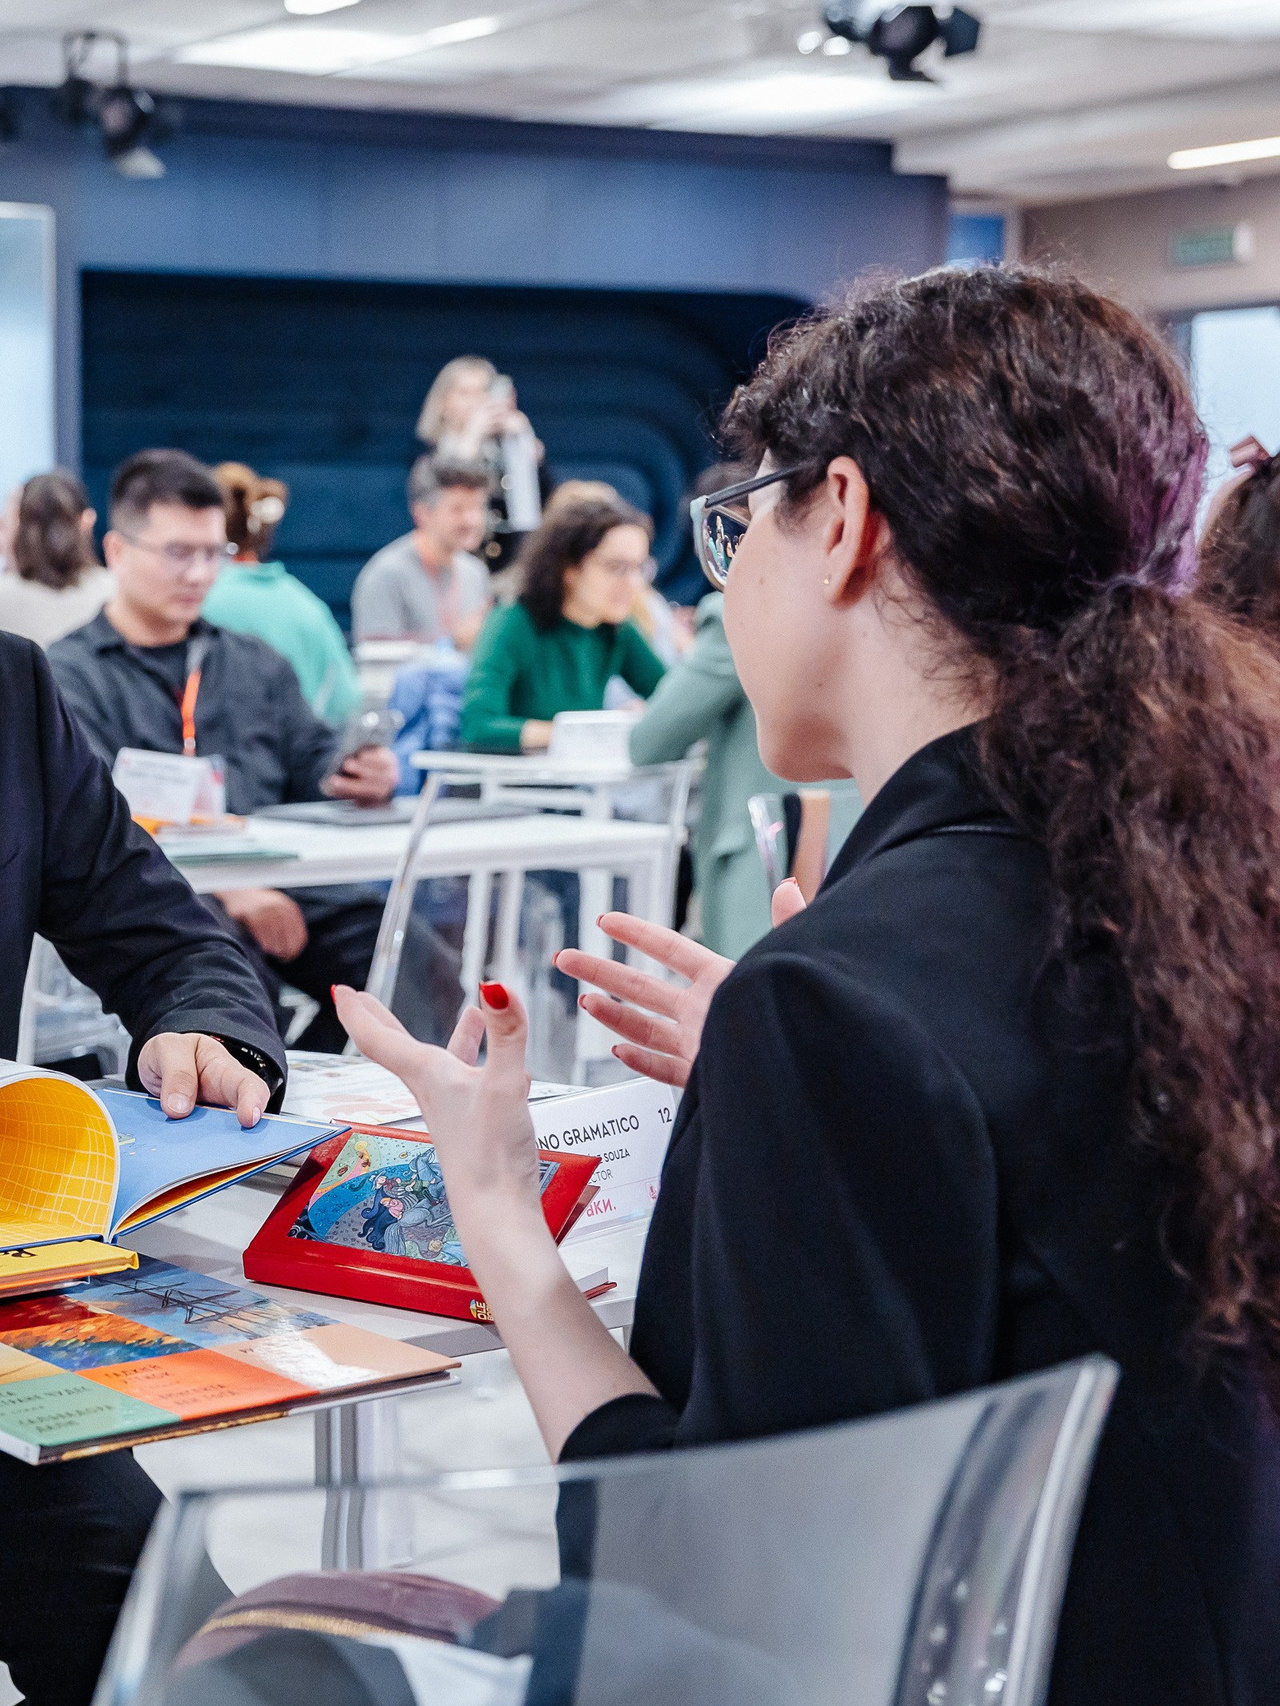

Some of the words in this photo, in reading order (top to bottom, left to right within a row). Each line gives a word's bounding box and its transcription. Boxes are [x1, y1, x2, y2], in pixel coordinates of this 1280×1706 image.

[657, 1107, 673, 1124] 12
[535, 1133, 560, 1150] NO
[562, 1114, 640, 1147] GRAMATICO
[603, 1148, 631, 1163] SOUZA
